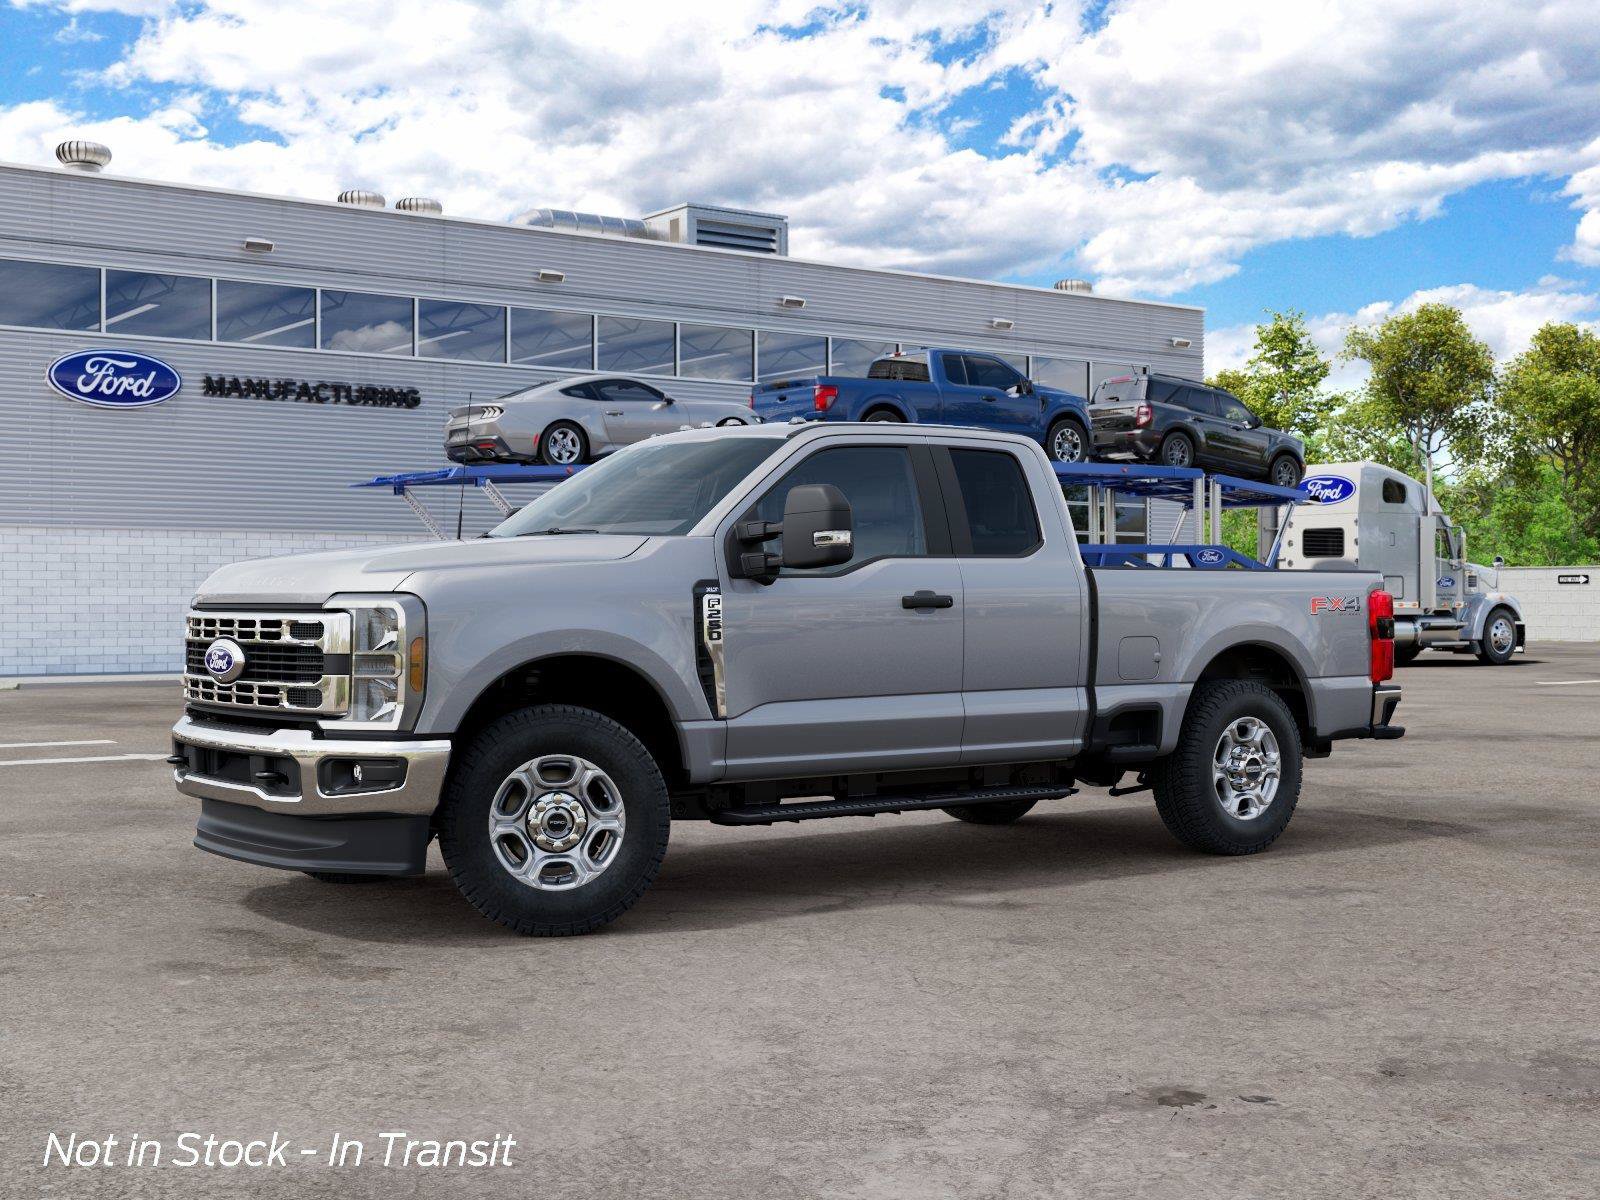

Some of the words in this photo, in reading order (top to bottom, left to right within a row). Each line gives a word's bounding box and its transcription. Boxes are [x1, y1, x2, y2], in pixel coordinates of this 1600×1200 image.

[76, 356, 157, 397] Ford
[202, 374, 421, 409] MANUFACTURING
[1310, 596, 1361, 616] FX4
[210, 650, 229, 670] Ford
